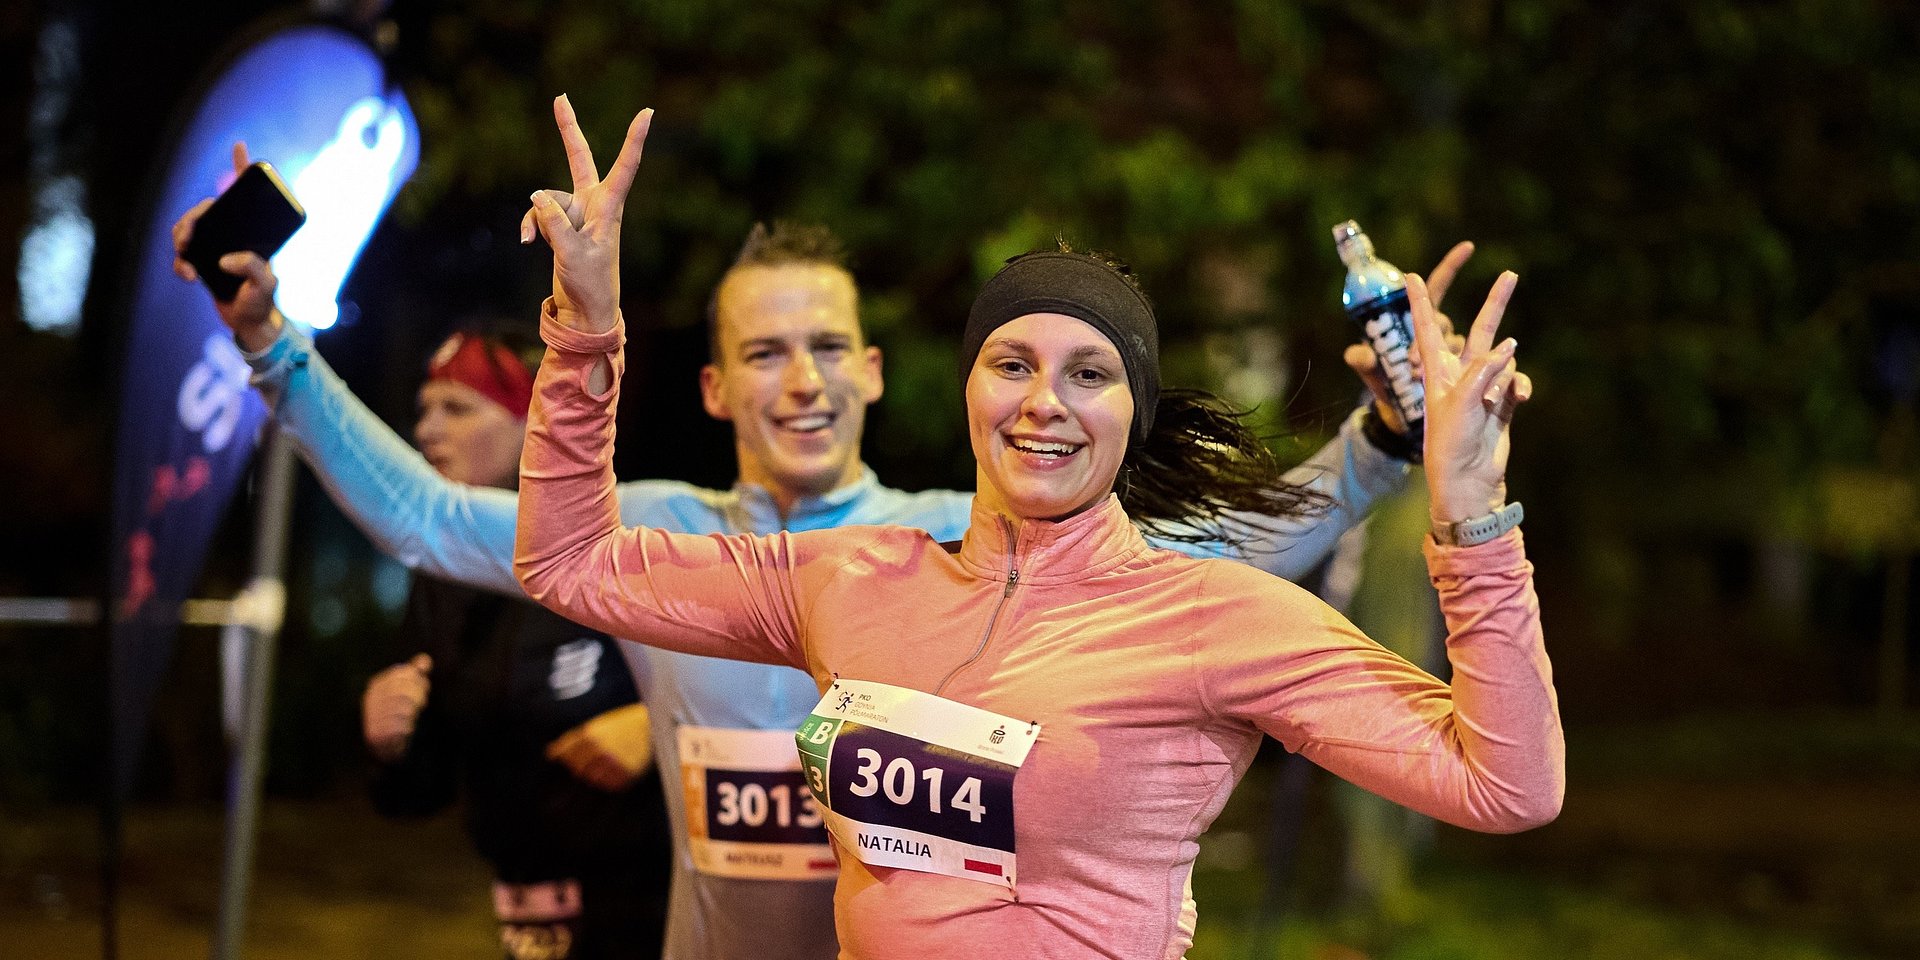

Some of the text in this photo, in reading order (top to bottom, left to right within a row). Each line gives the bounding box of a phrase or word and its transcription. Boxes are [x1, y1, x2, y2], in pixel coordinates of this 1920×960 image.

[859, 693, 872, 702] PKO
[809, 721, 834, 745] B
[809, 766, 824, 792] 3
[849, 747, 987, 823] 3014
[857, 833, 932, 859] NATALIA
